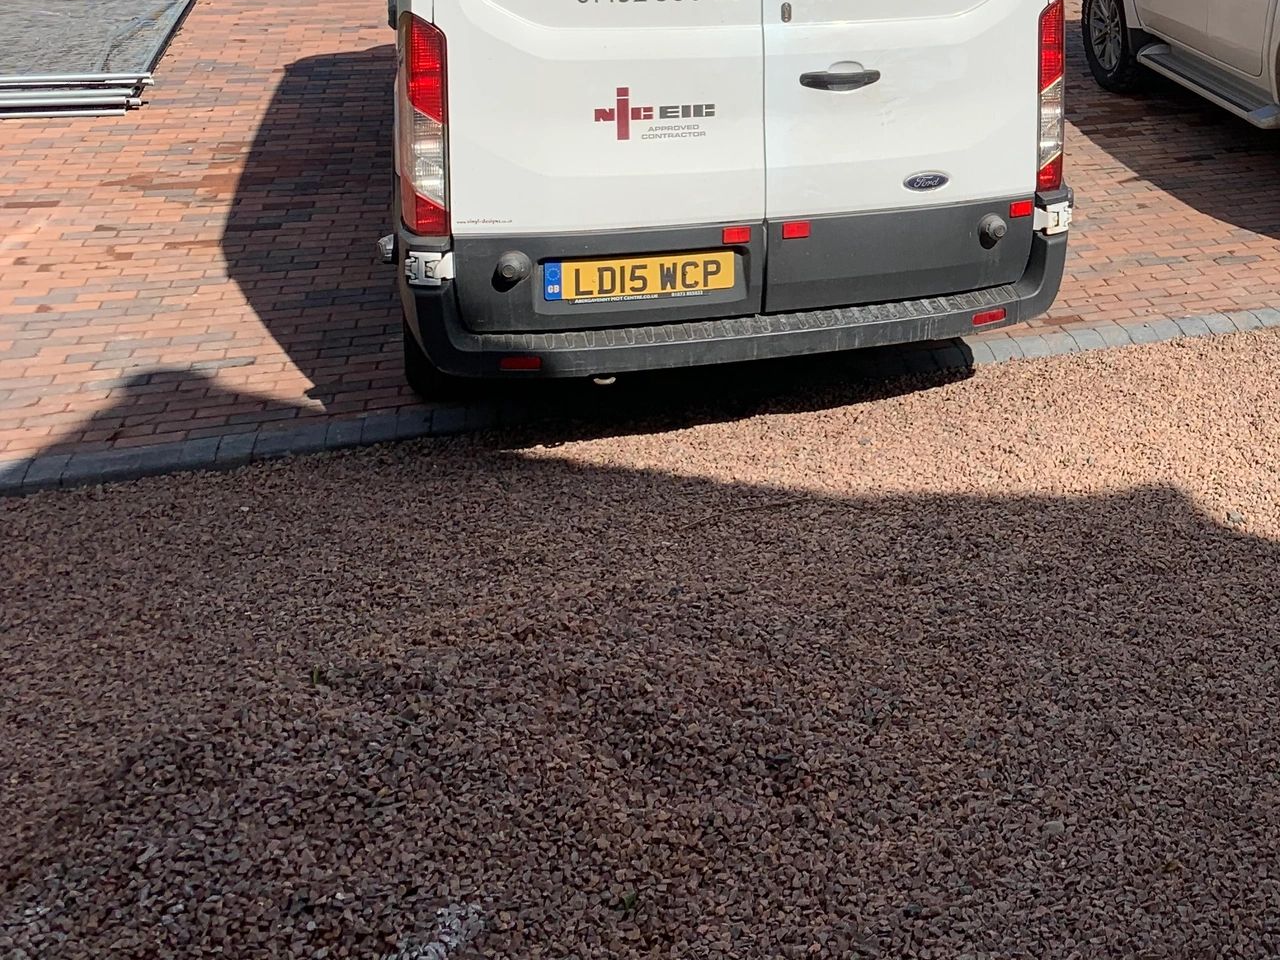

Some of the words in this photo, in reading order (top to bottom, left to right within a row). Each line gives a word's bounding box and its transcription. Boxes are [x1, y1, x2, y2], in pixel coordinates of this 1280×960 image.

[647, 124, 700, 132] APPROVED
[641, 131, 706, 140] CONTRACTOR
[574, 264, 648, 297] LD15
[659, 259, 722, 292] WCP
[547, 284, 560, 294] GB
